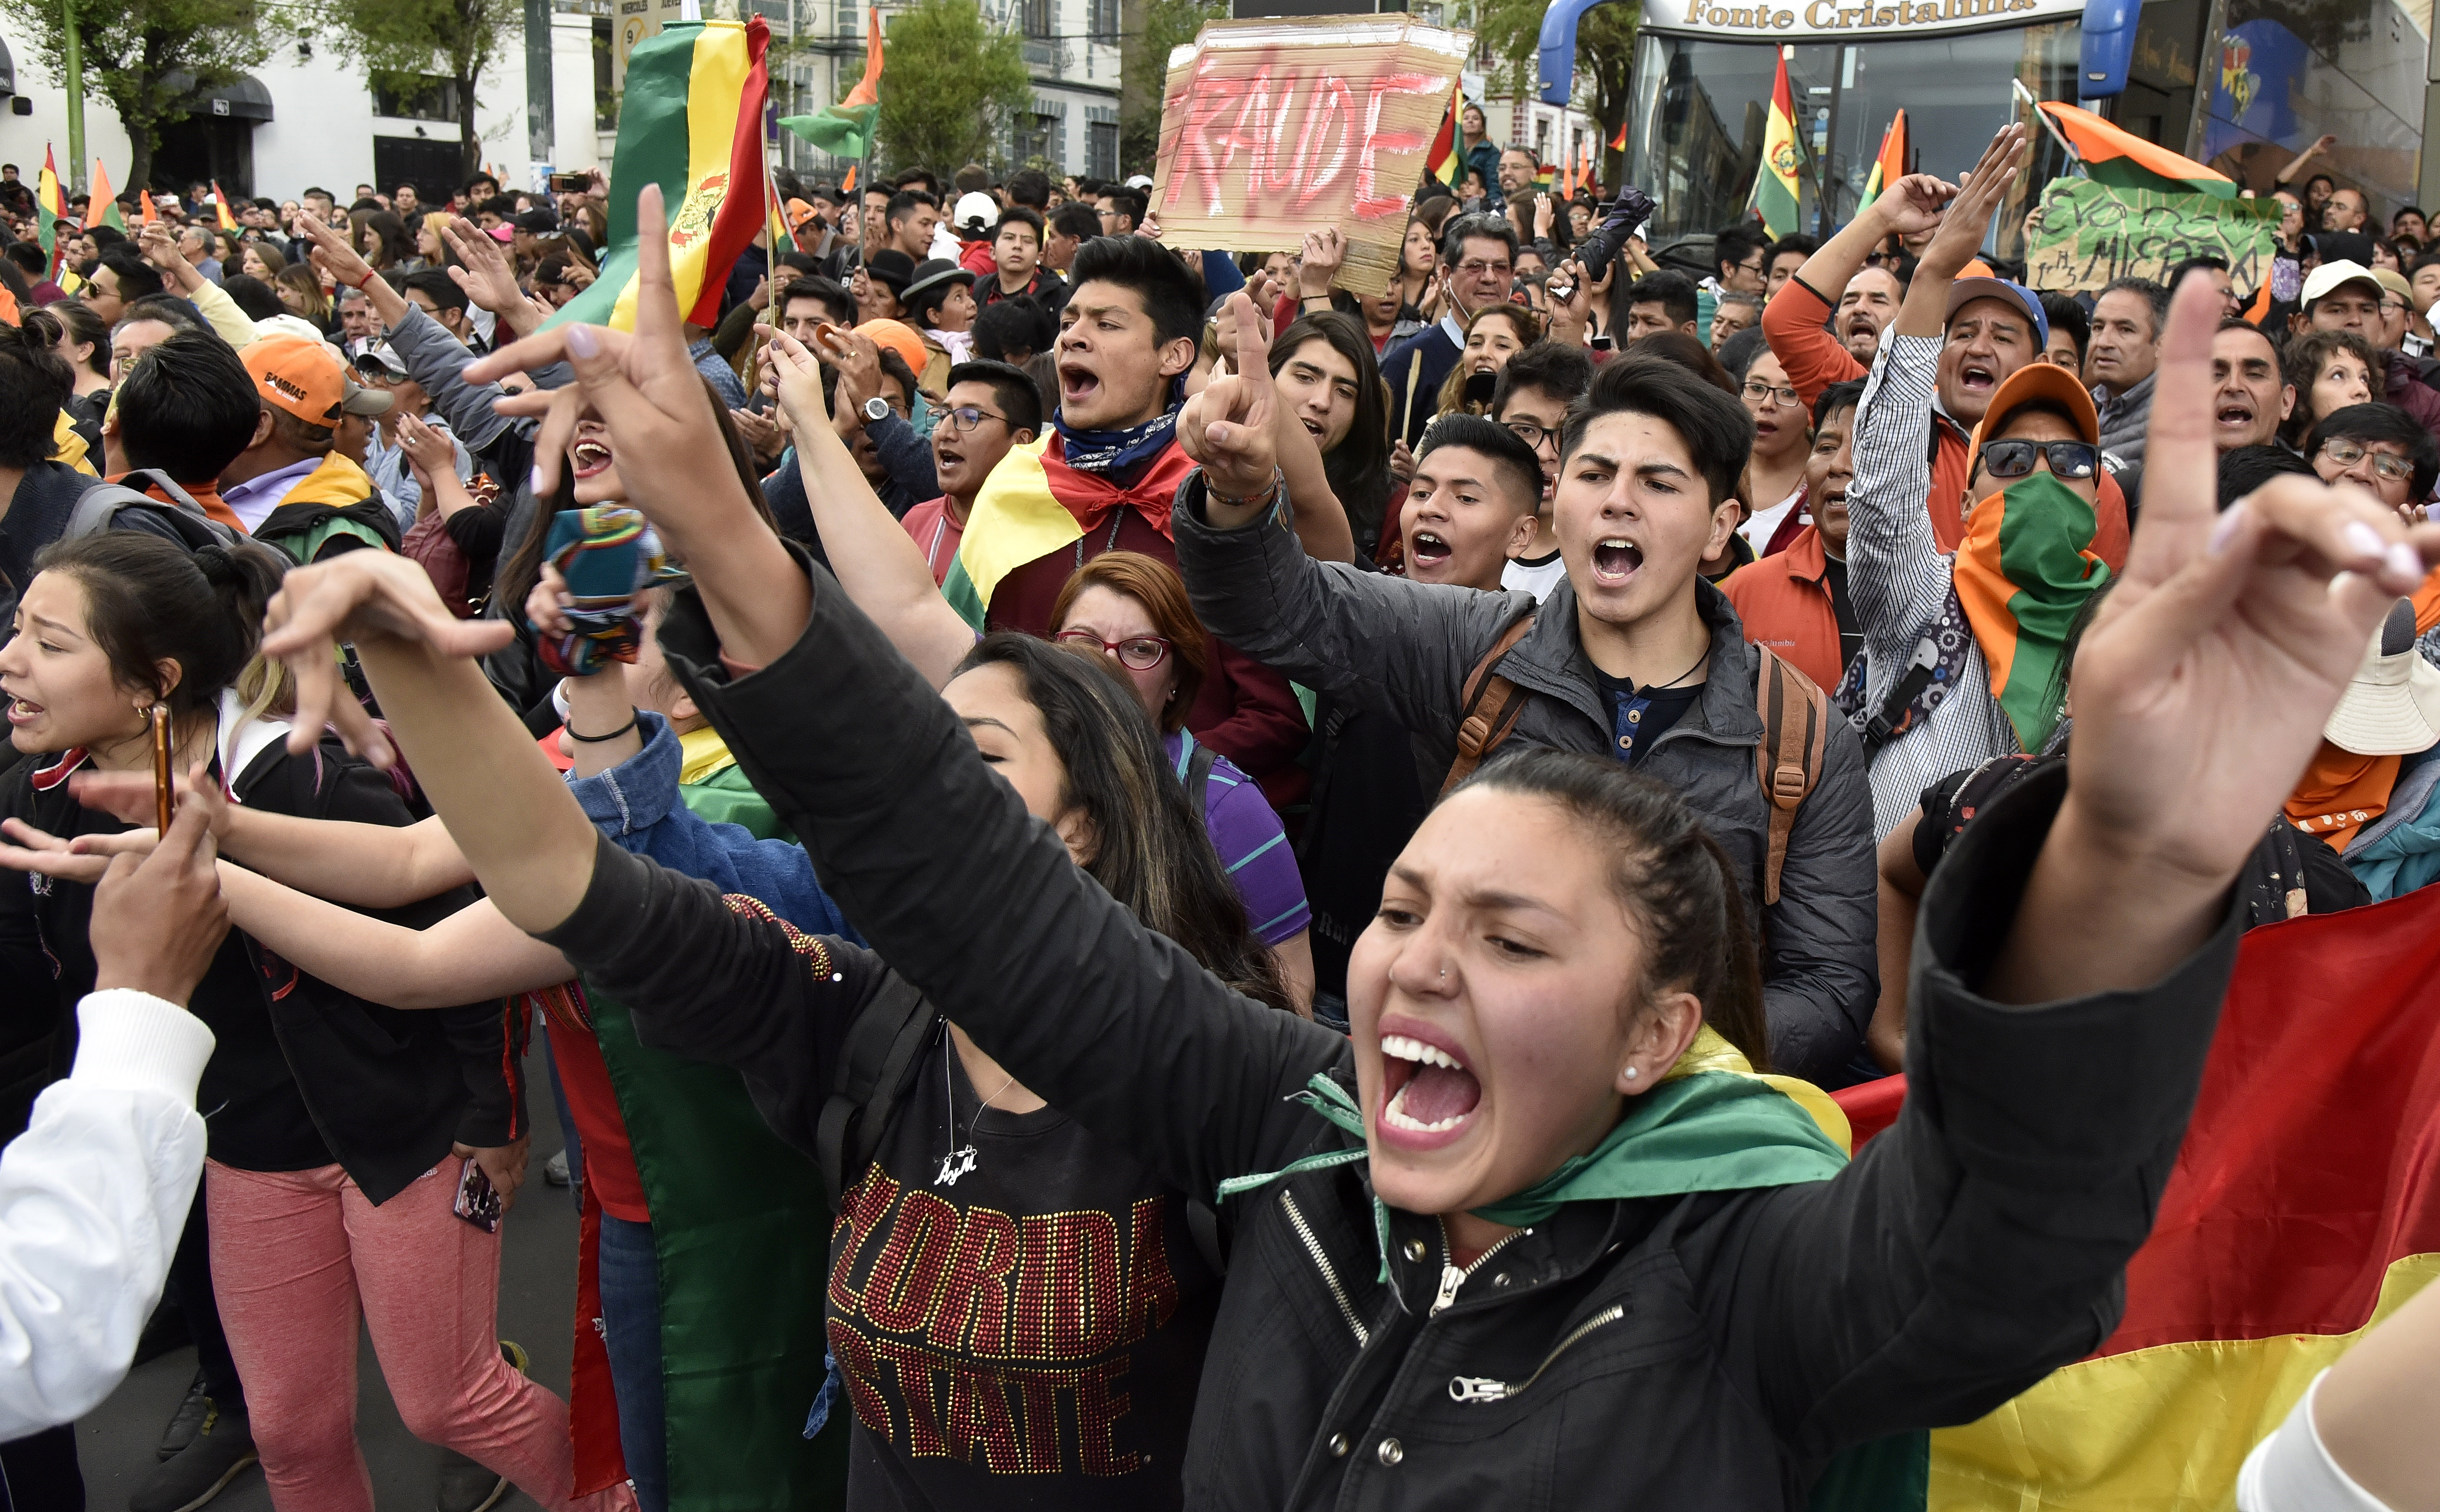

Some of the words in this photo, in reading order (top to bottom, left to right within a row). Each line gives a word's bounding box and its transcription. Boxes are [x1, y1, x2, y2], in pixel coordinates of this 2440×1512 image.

[627, 29, 634, 44] 9
[1683, 0, 1794, 29] Fonte
[1804, 0, 2036, 29] Cristalina
[2041, 188, 2126, 234] EVO
[828, 1161, 1179, 1360] LORIDA
[826, 1316, 1140, 1477] STATE
